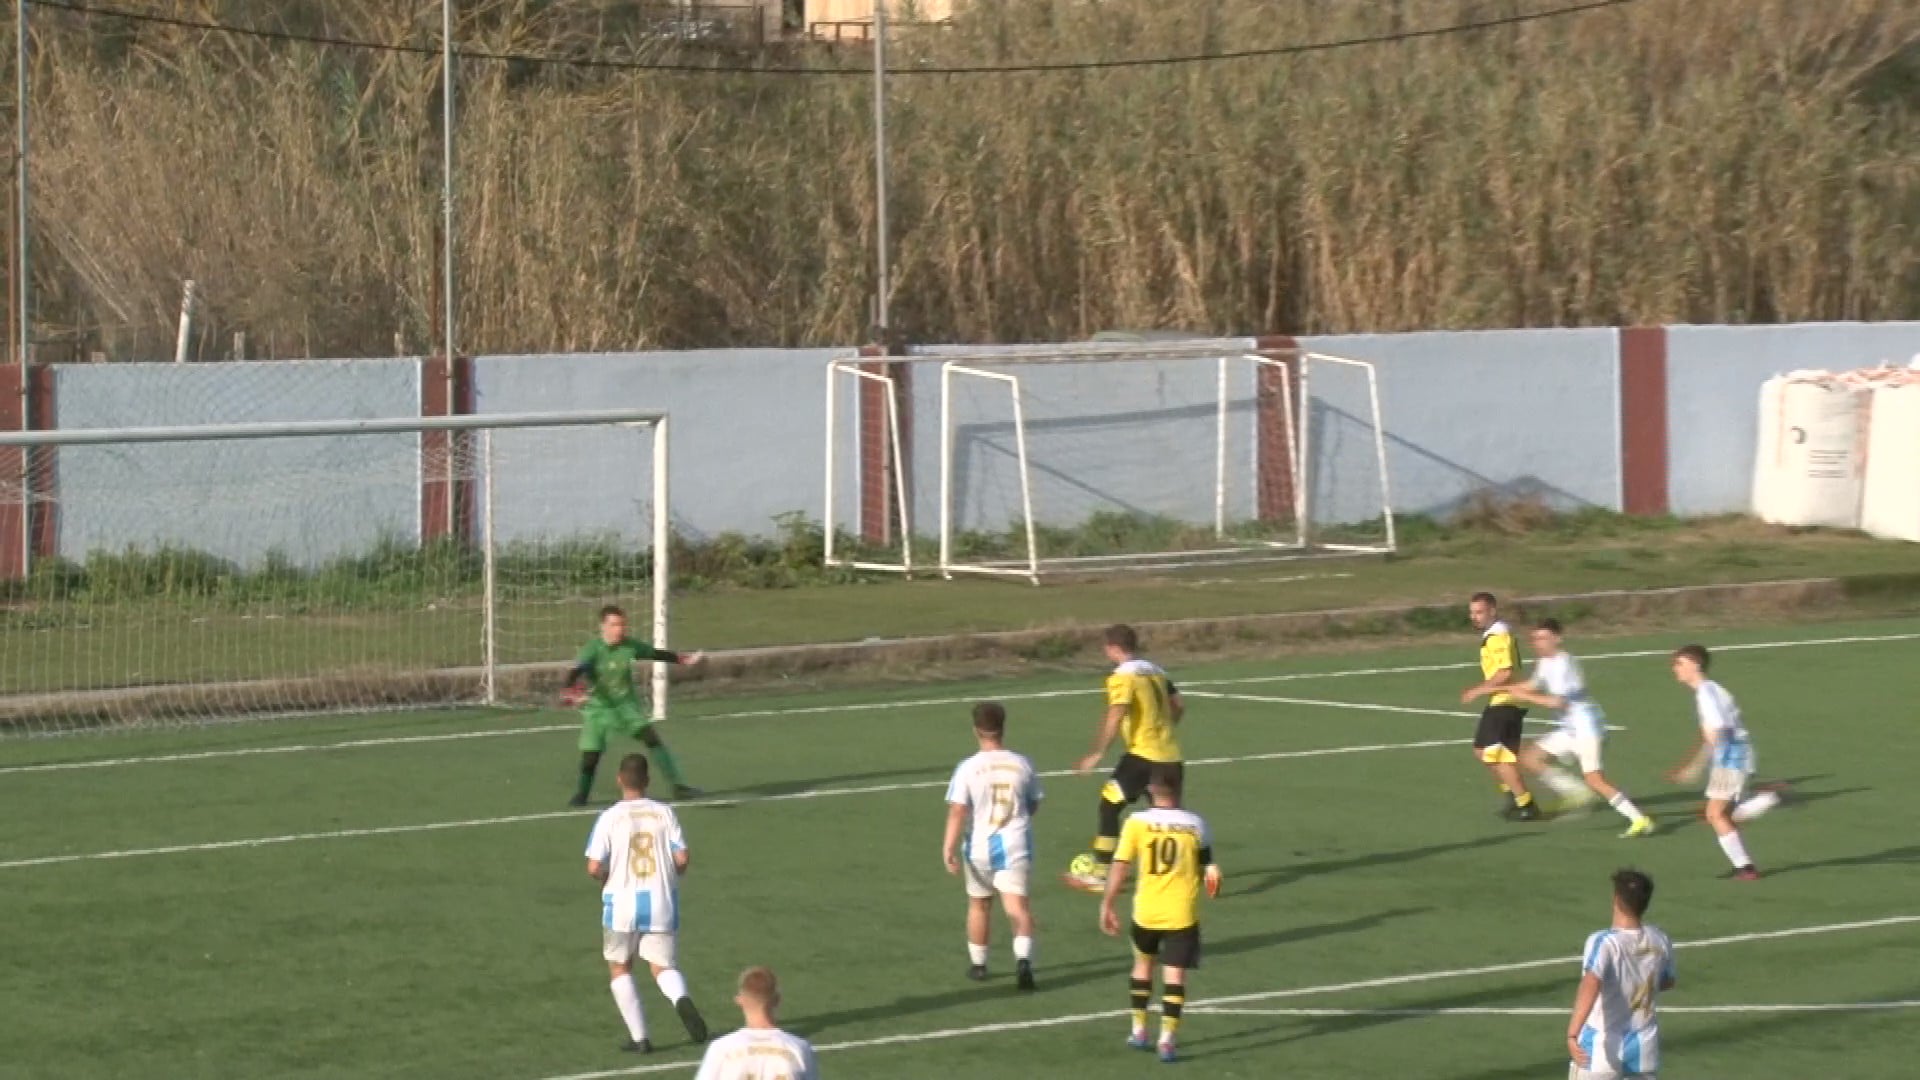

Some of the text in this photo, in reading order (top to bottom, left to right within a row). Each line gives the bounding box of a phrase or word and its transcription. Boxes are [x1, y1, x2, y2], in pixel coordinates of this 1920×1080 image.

[989, 783, 1015, 829] 5
[631, 832, 656, 878] 8
[1146, 837, 1177, 875] 19
